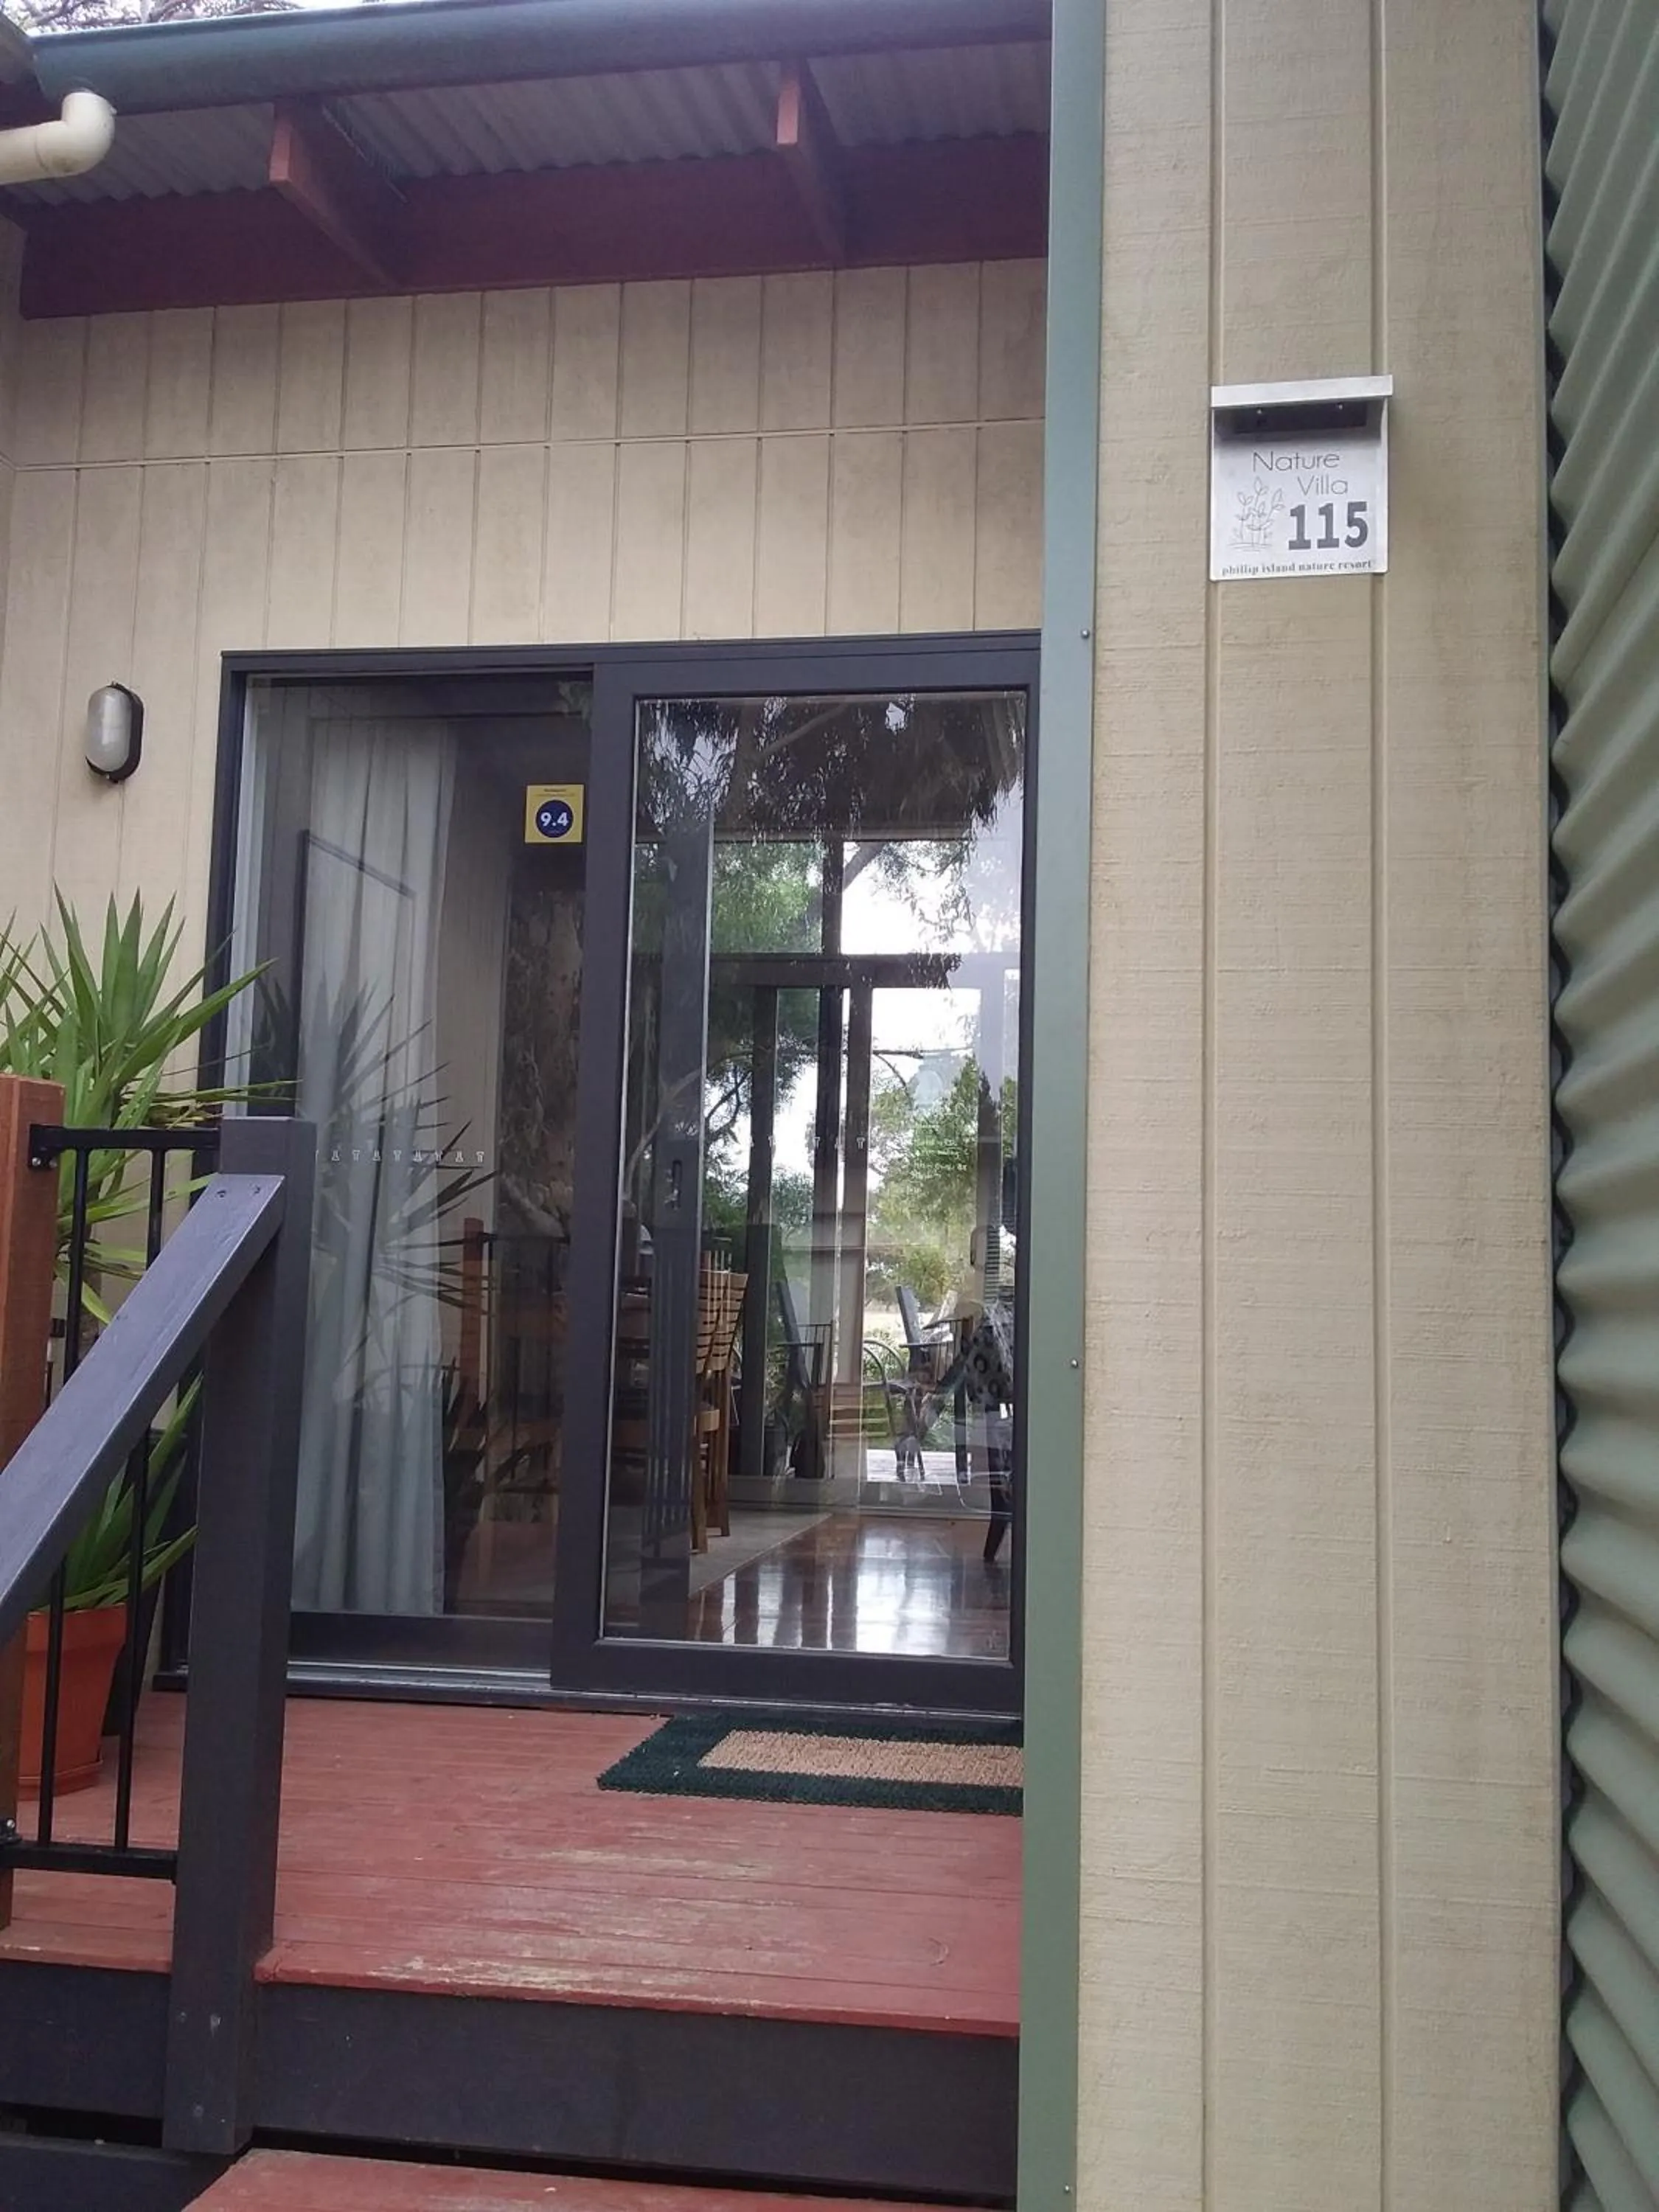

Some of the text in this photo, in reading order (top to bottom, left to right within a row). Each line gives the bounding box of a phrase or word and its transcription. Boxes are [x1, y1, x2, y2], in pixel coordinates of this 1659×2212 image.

[1253, 451, 1340, 473] Nature
[1296, 473, 1349, 496] Villa
[1288, 501, 1369, 551] 115
[1221, 559, 1372, 577] phillip island nature resort
[540, 812, 569, 827] 9.4
